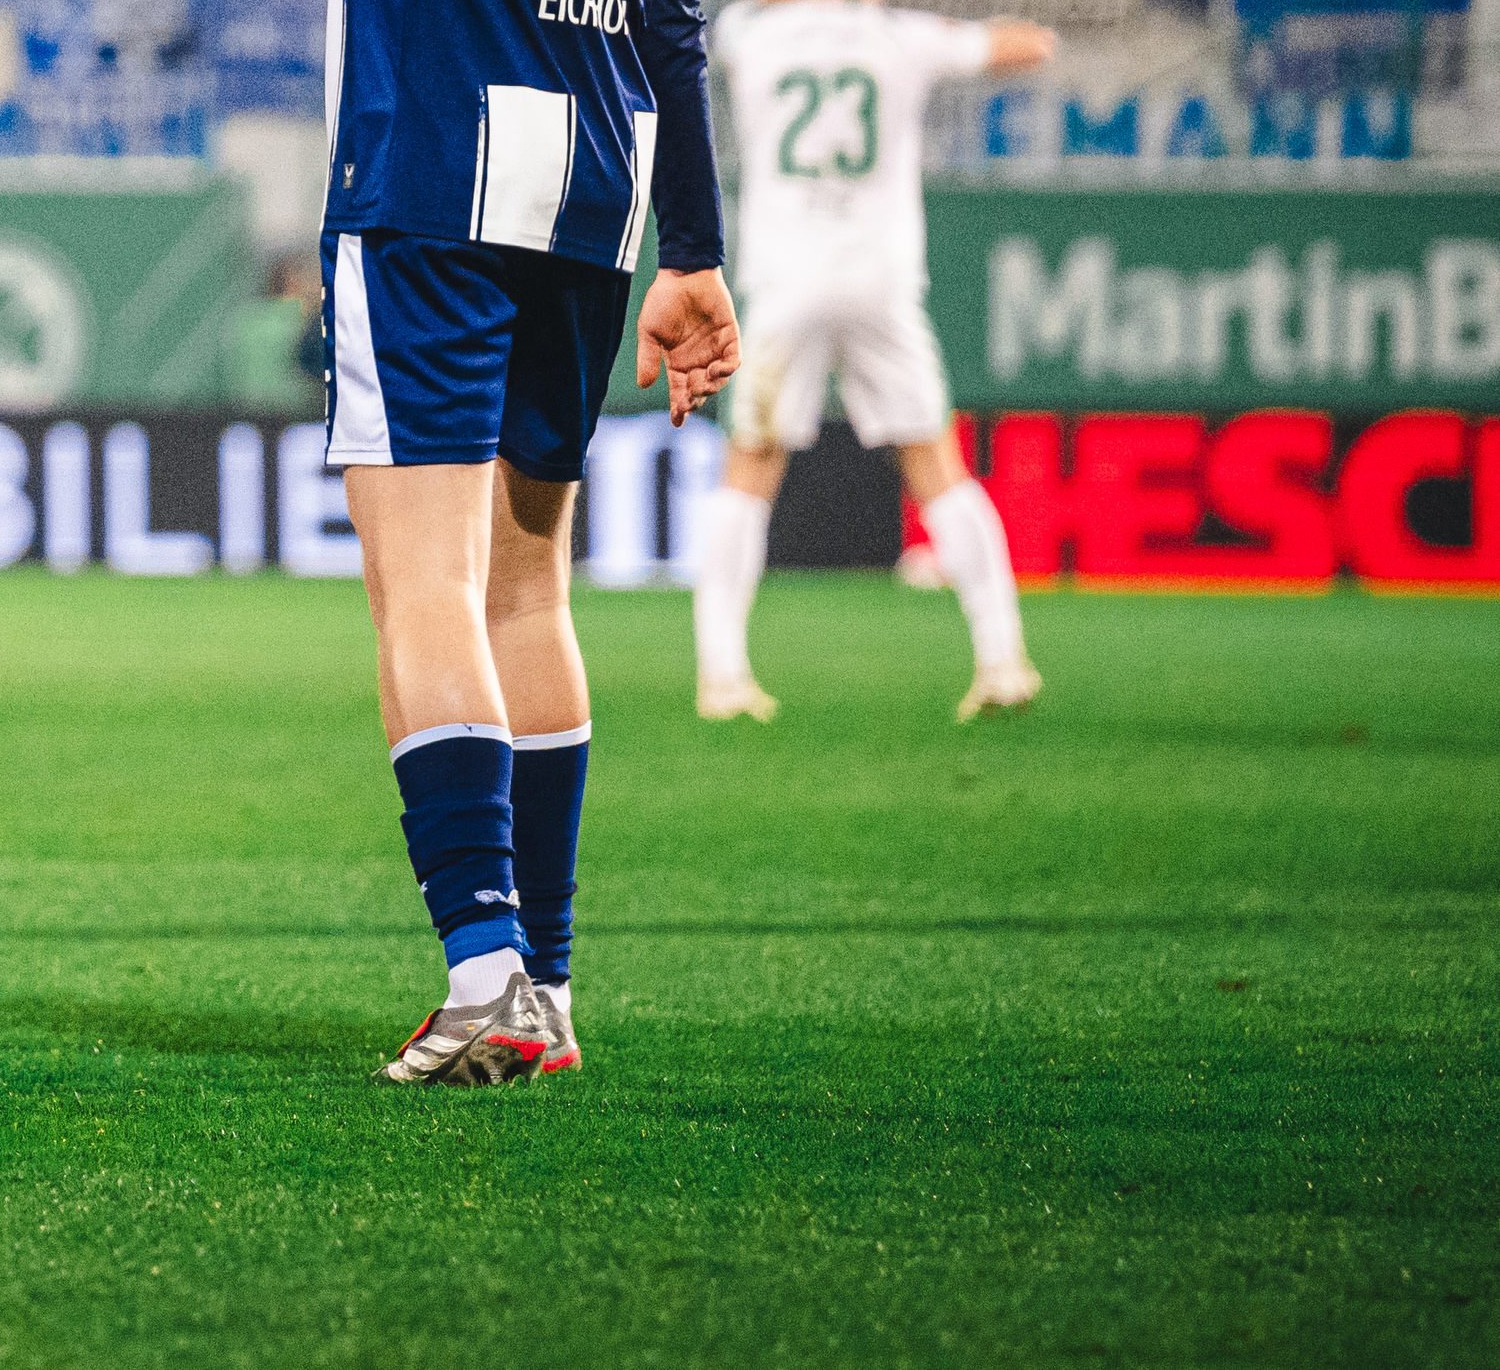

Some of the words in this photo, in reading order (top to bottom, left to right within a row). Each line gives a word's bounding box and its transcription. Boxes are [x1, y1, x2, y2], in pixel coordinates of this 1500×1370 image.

[776, 67, 880, 178] 23
[982, 94, 1413, 160] EMANN
[990, 240, 1500, 385] MartinB
[905, 408, 1500, 585] HESC
